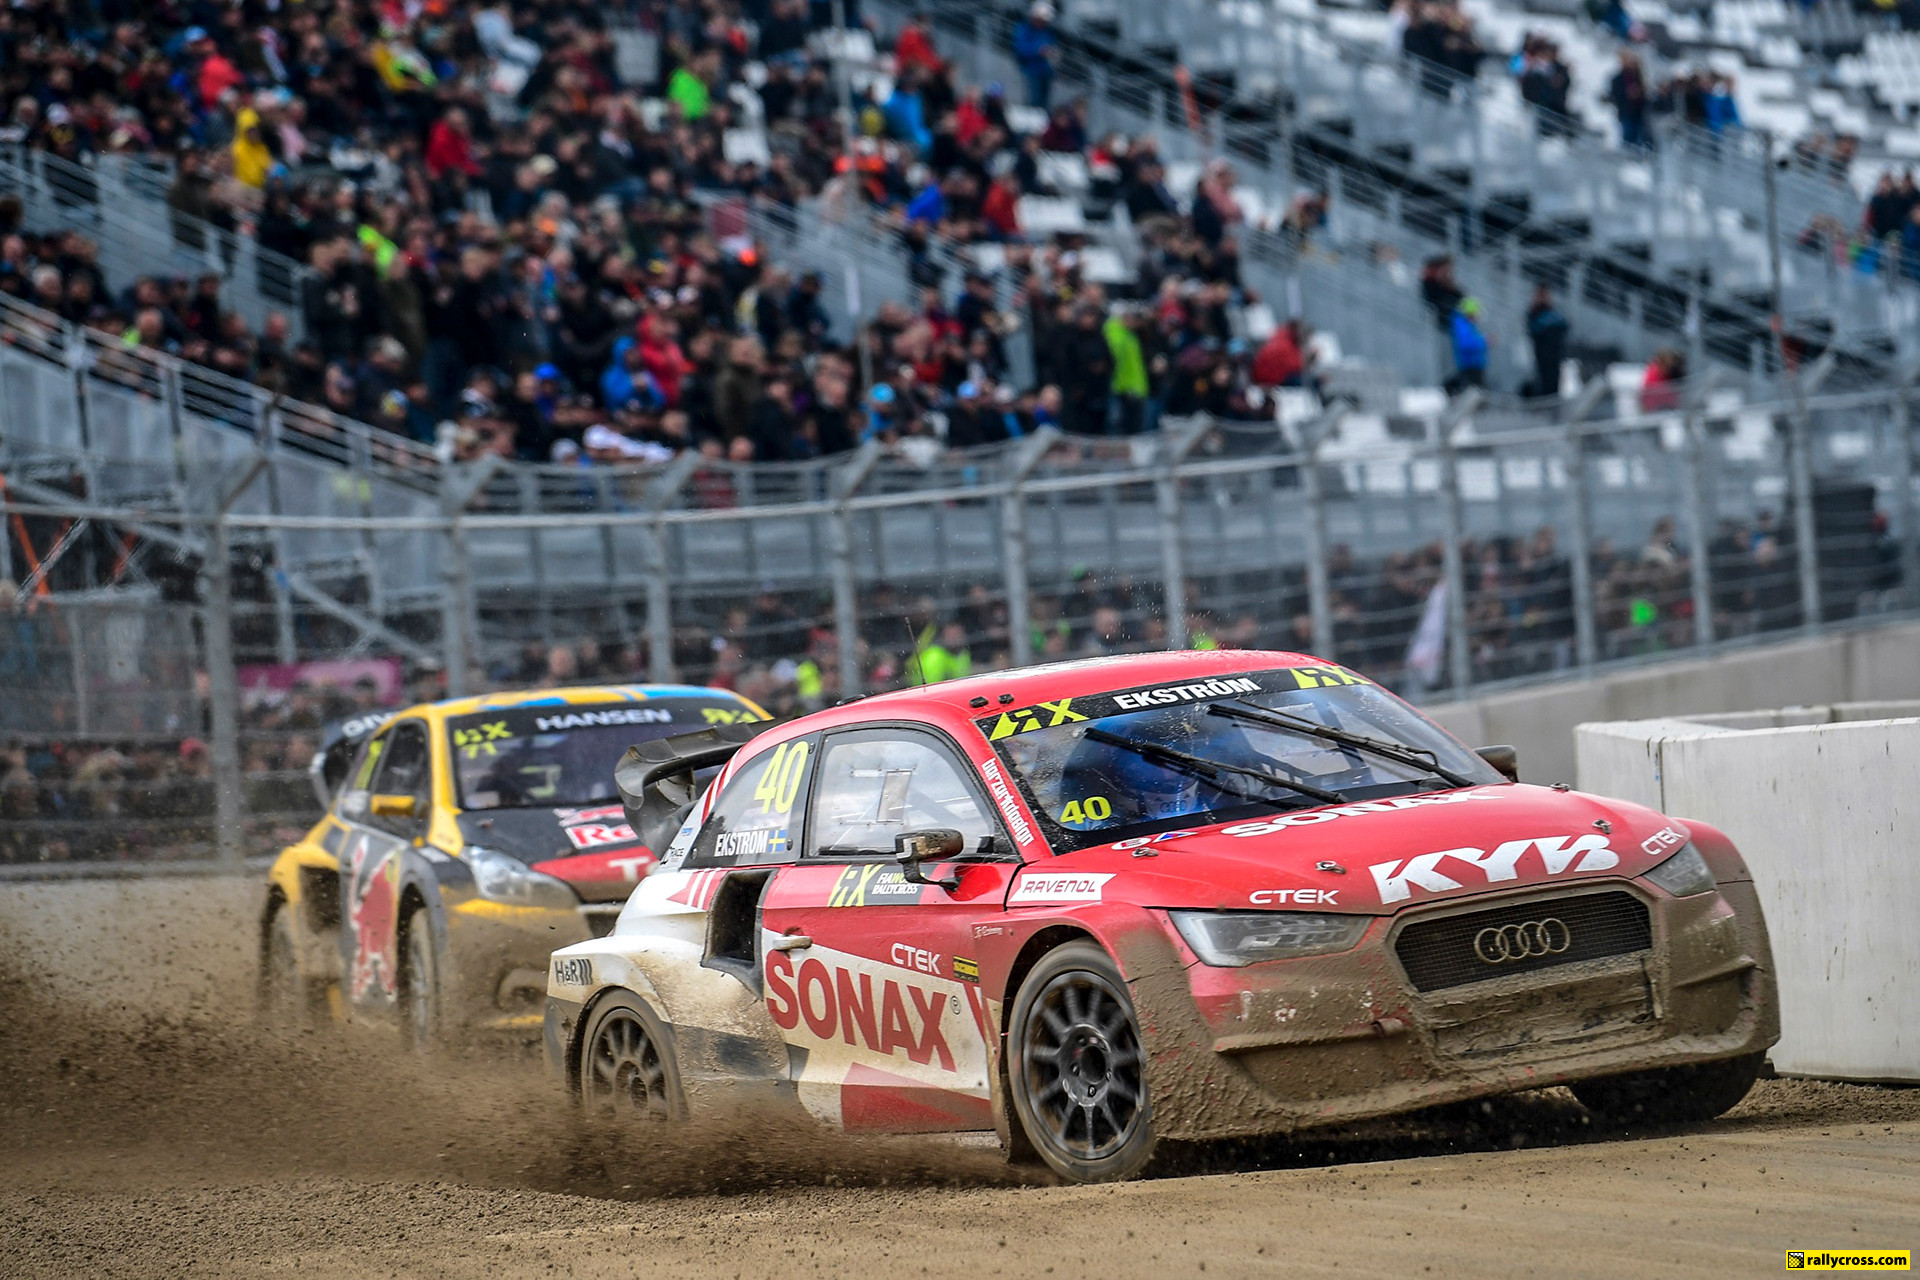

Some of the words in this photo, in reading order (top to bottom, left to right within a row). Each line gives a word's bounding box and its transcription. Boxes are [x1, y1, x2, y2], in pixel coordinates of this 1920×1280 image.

[1113, 677, 1261, 710] EKSTRÖM
[535, 708, 673, 731] HANSEN
[754, 740, 809, 815] 40
[1059, 796, 1112, 826] 40
[1221, 790, 1504, 838] SONAX
[1641, 826, 1684, 857] CTEK
[1369, 834, 1620, 905] KYB
[871, 883, 919, 895] RALLYCROSS
[1023, 880, 1096, 894] RAVENOL
[1249, 889, 1339, 905] CTEK
[891, 942, 941, 975] CTEK
[765, 950, 957, 1073] SONAX
